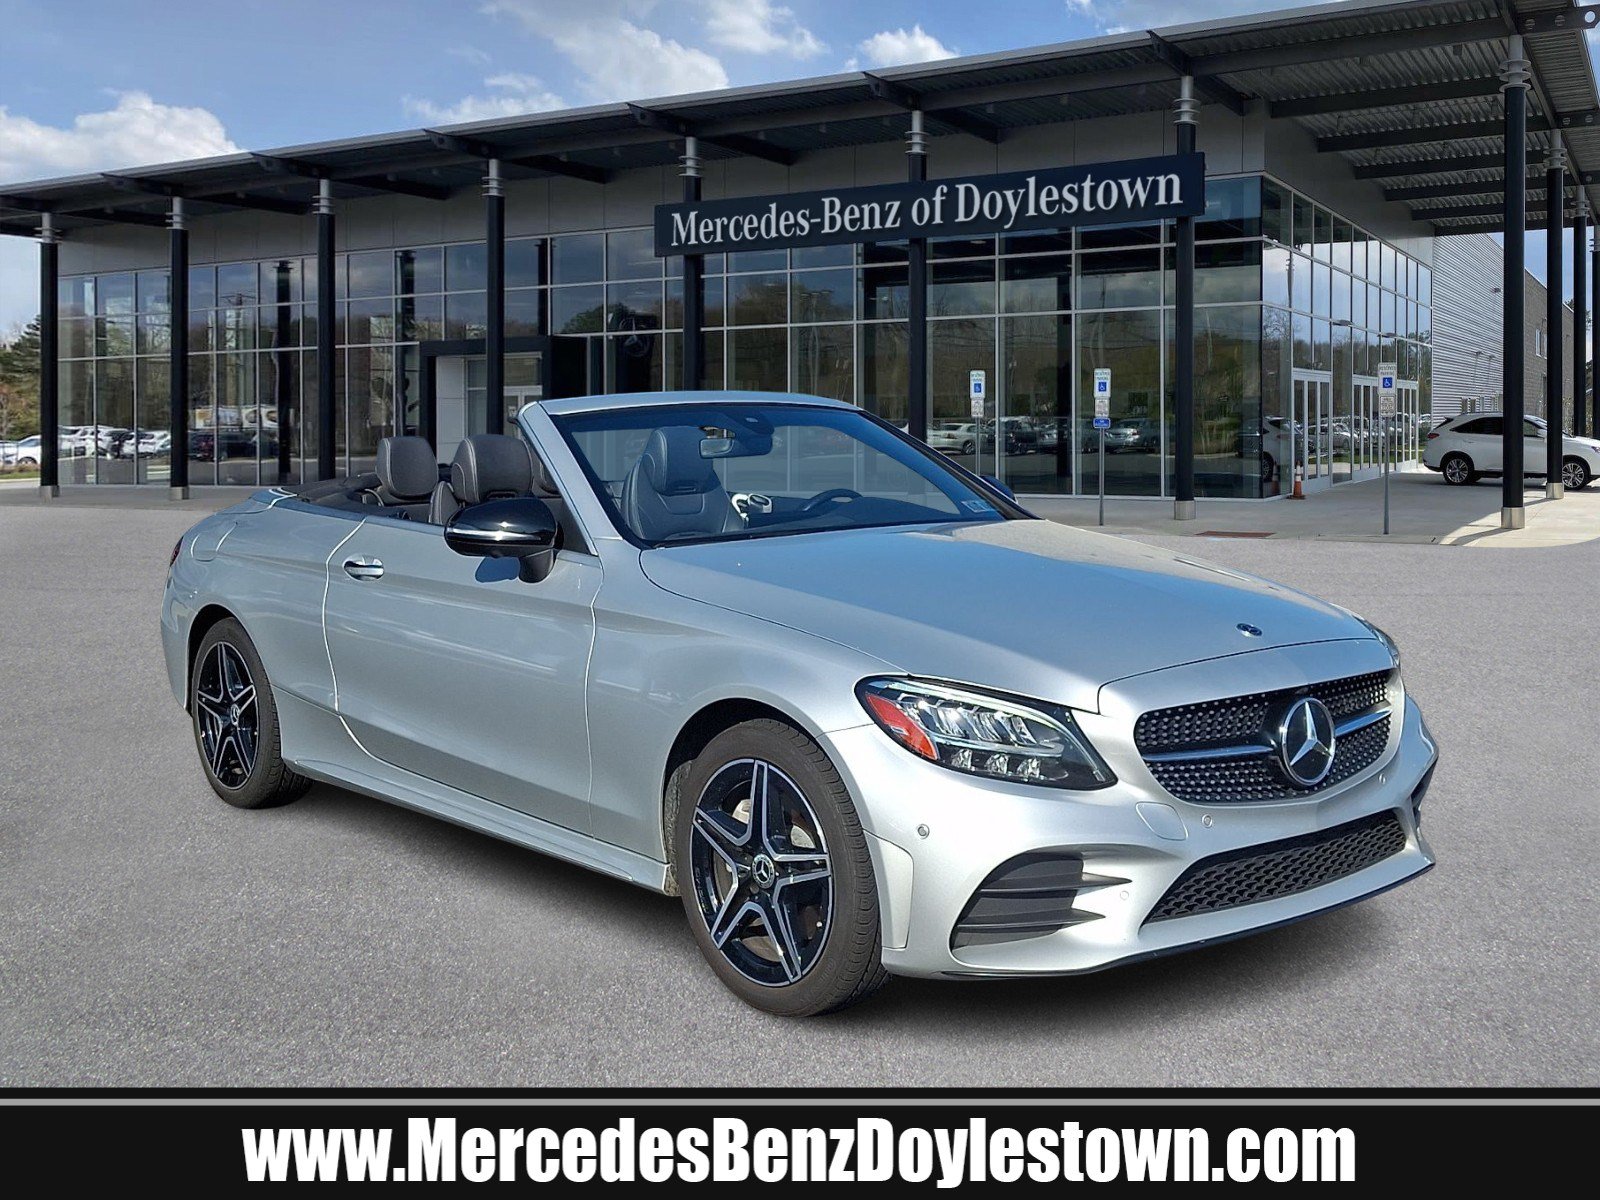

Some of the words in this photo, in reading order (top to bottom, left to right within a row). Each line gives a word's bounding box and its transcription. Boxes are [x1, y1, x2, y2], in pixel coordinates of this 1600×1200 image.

[670, 197, 901, 246] Mercedes-Benz
[911, 184, 948, 226] of
[953, 173, 1184, 229] Doylestown
